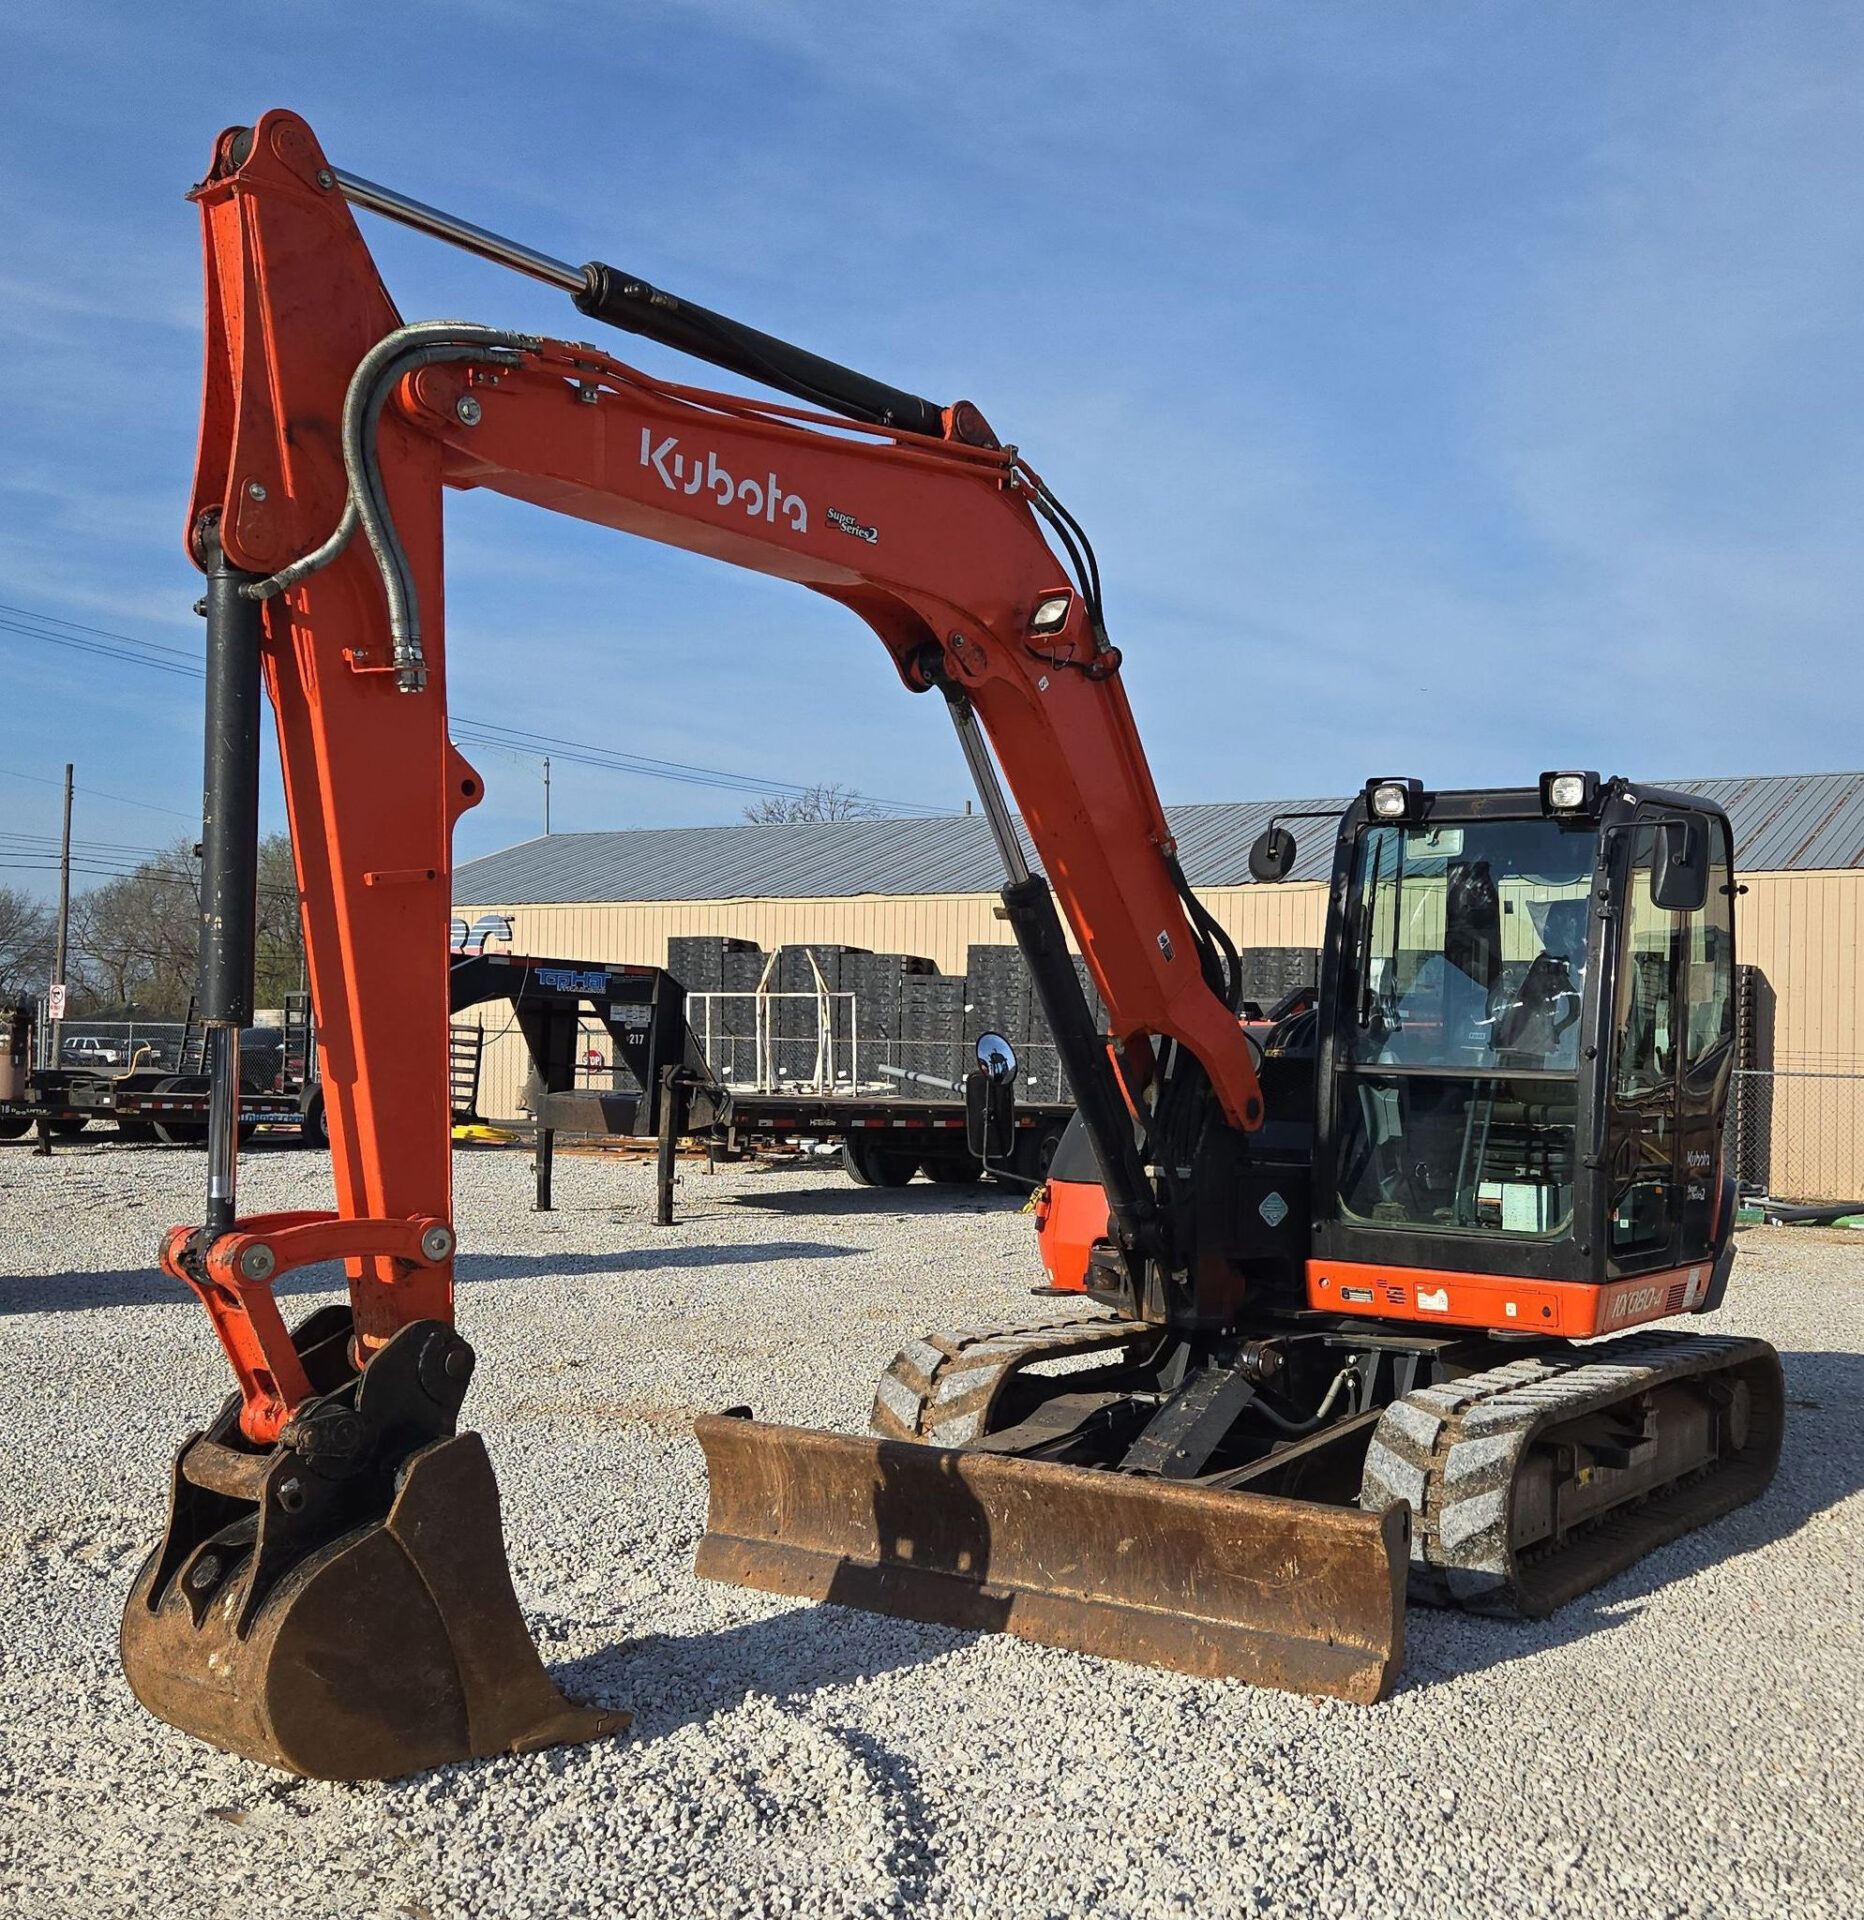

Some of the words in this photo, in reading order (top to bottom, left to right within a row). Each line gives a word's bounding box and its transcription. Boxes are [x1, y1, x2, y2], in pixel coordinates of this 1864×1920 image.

[640, 427, 808, 533] Kubota
[827, 507, 856, 525] Super
[629, 1034, 644, 1045] 217
[582, 1055, 601, 1066] STOP
[1611, 1287, 1665, 1319] KX080-4
